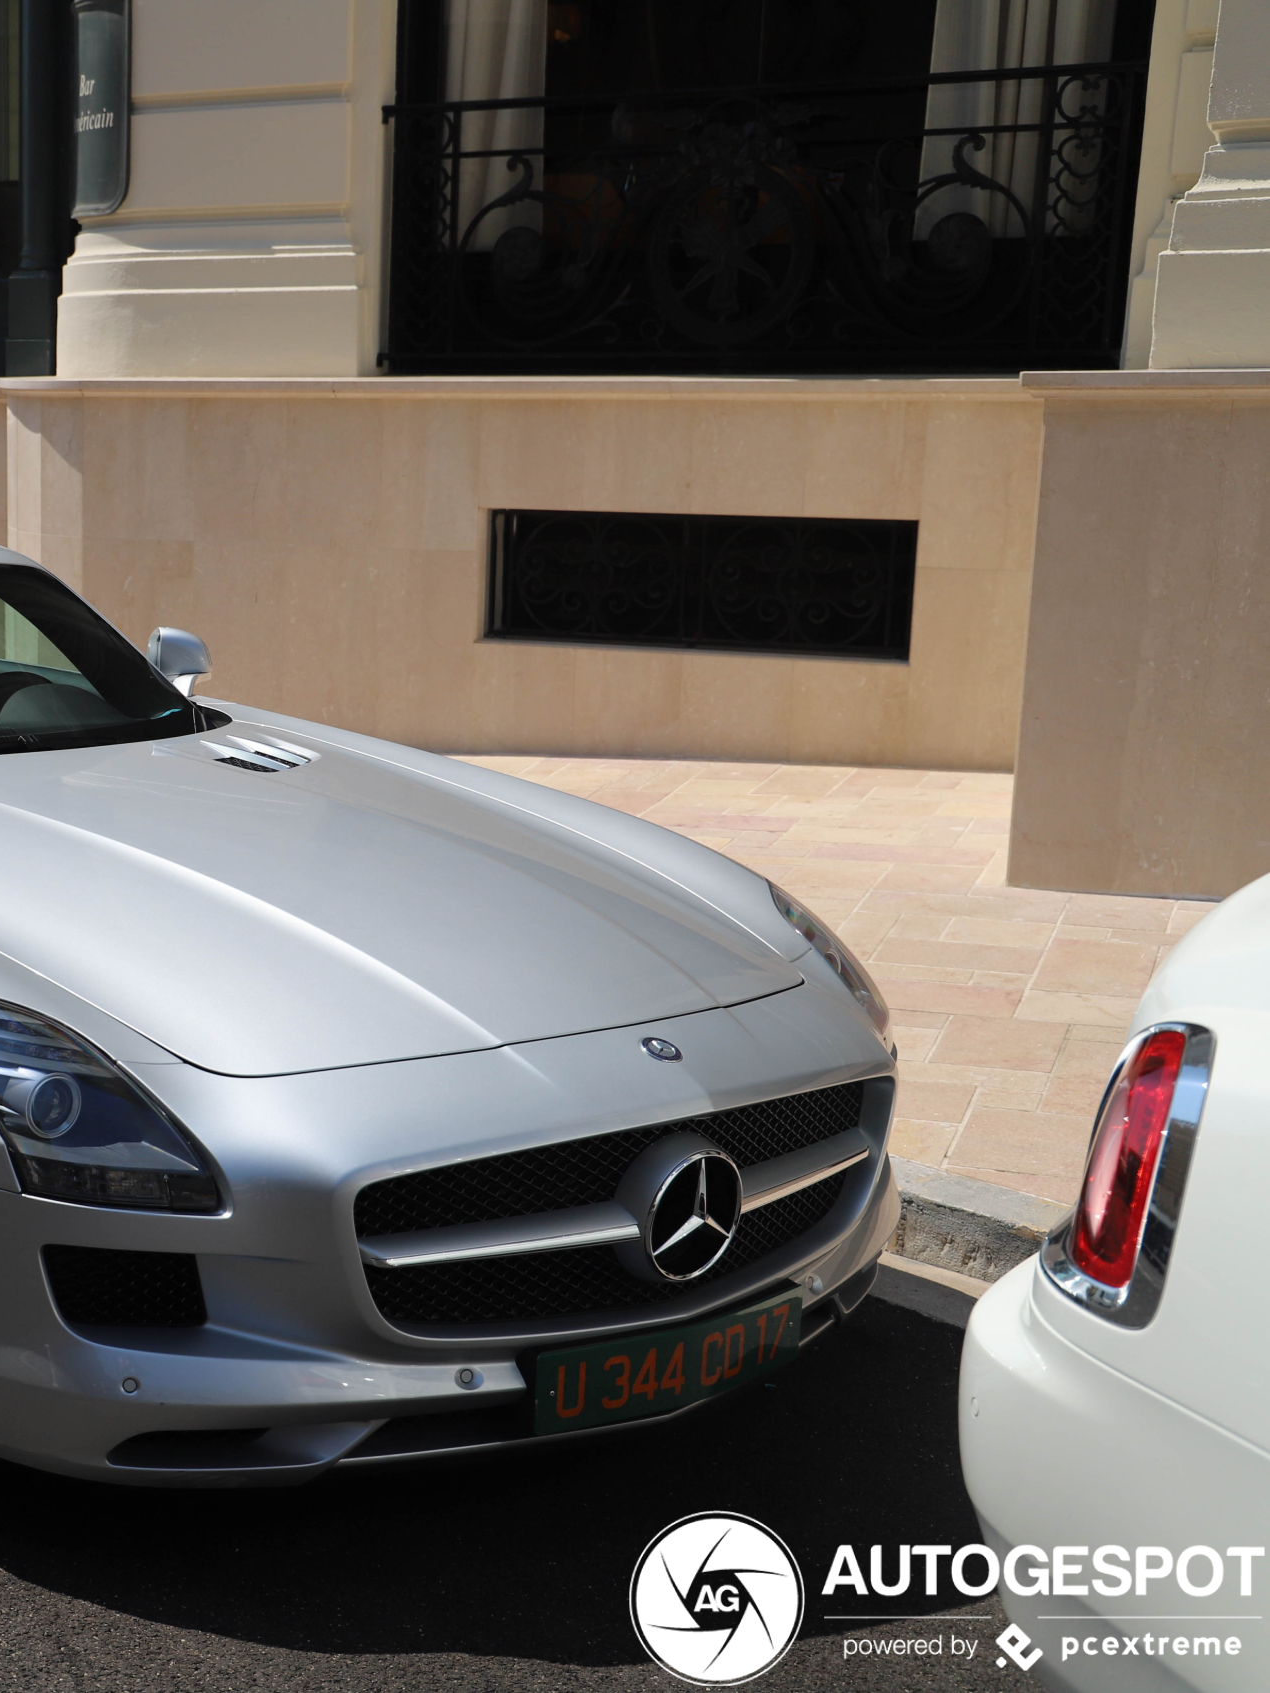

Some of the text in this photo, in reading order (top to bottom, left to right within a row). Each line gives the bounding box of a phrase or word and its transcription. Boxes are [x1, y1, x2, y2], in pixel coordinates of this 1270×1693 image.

[79, 74, 95, 97] Bar
[75, 107, 114, 132] éricain
[556, 1303, 791, 1419] U 344 CD 17
